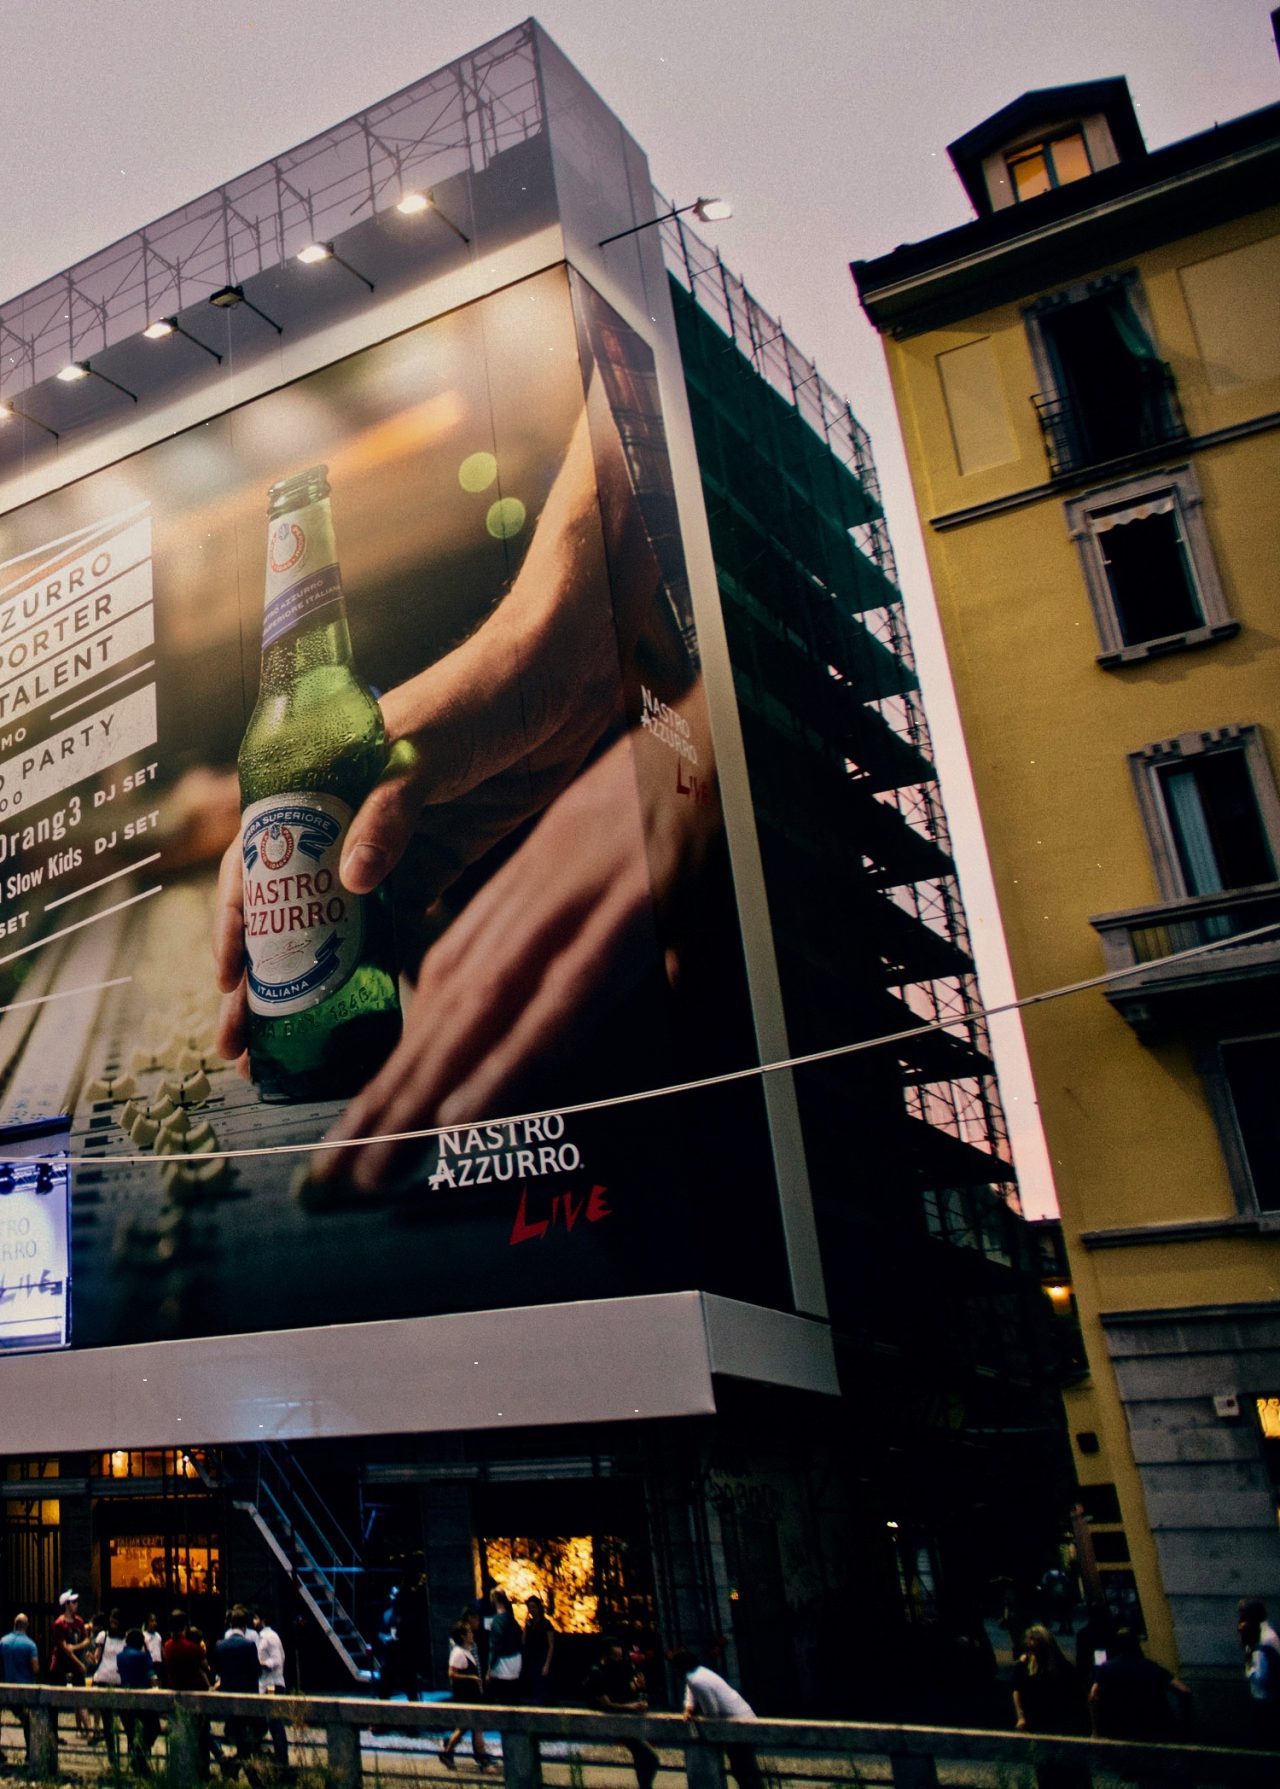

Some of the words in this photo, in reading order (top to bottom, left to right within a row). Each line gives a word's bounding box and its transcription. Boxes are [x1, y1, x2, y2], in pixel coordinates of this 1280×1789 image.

[22, 713, 116, 780] PARTY
[94, 782, 116, 808] DJ
[122, 762, 160, 794] SET
[262, 811, 331, 830] SUPERIORE
[6, 863, 44, 902] Slow
[48, 845, 83, 880] Kids
[95, 830, 117, 856] DJ
[124, 809, 161, 841] SET
[245, 869, 333, 907] NASTRO
[257, 980, 310, 998] ITALIANA
[438, 1114, 565, 1158] NASTRO
[428, 1143, 581, 1191] AZZURRO
